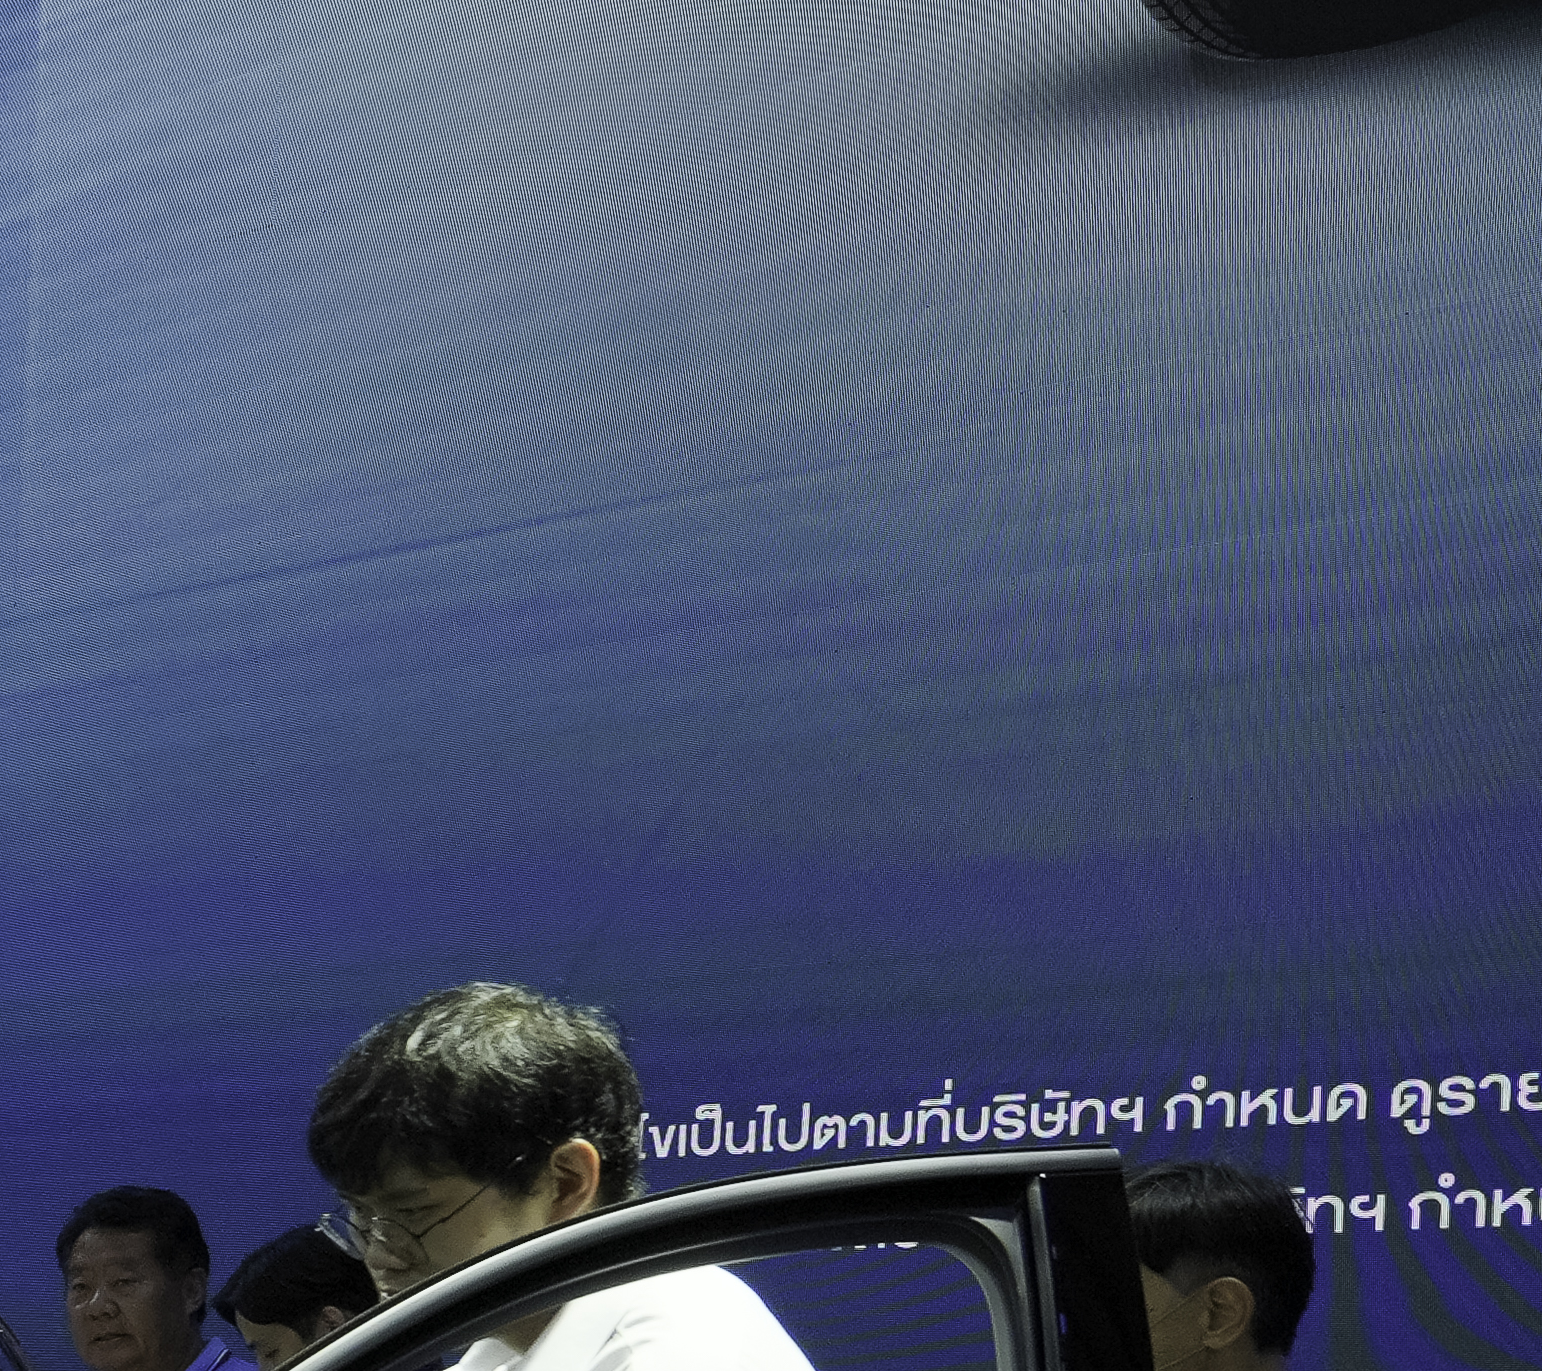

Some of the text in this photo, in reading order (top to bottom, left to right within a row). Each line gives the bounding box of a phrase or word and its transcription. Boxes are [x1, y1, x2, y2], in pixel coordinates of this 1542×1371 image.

[1164, 1075, 1368, 1134] กำหนด
[1290, 1172, 1542, 1233] ทฯ กำห
